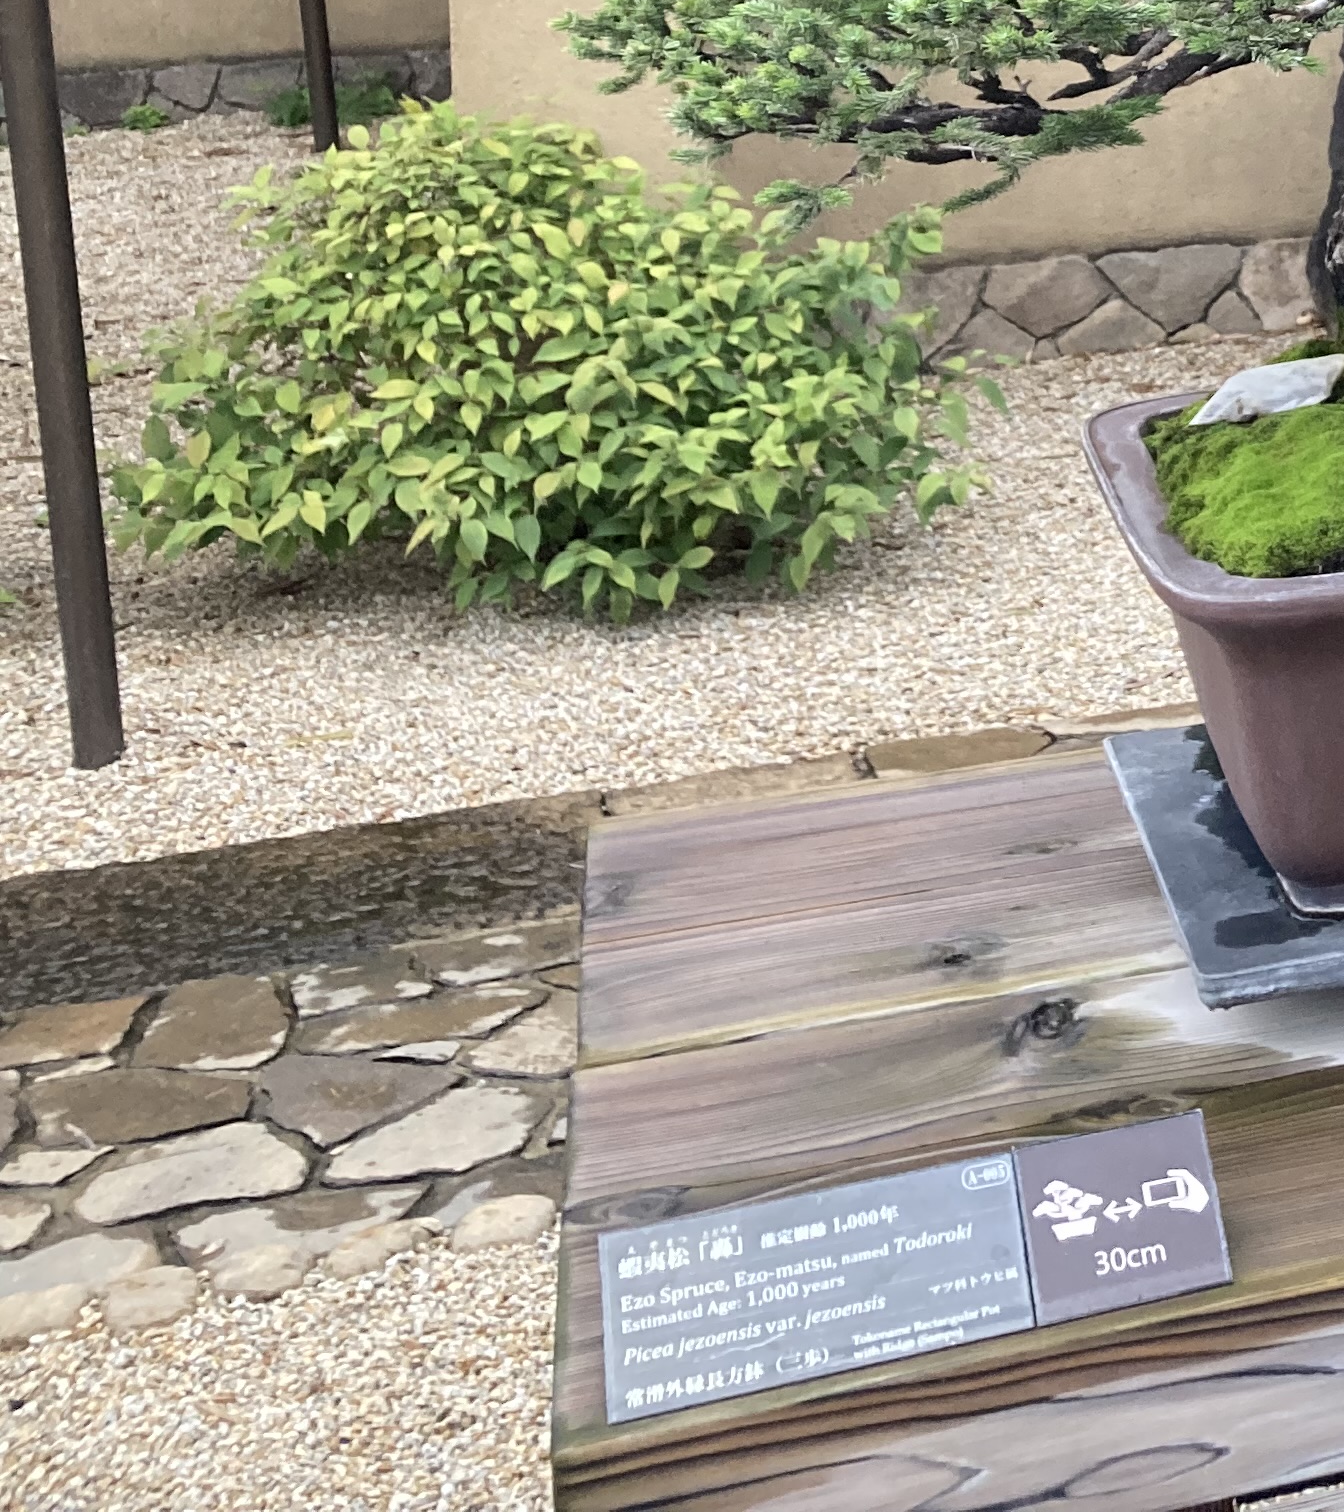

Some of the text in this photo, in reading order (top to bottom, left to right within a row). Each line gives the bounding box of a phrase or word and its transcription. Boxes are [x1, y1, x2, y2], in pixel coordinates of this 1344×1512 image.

[620, 1222, 972, 1312] Ezo Spruce, Ezo-matsu, named Todoroki
[1094, 1243, 1167, 1276] 30cm
[621, 1275, 845, 1334] Estimated Age: 1,000 years
[623, 1294, 885, 1366] Picea jezoensis var. jezoensis
